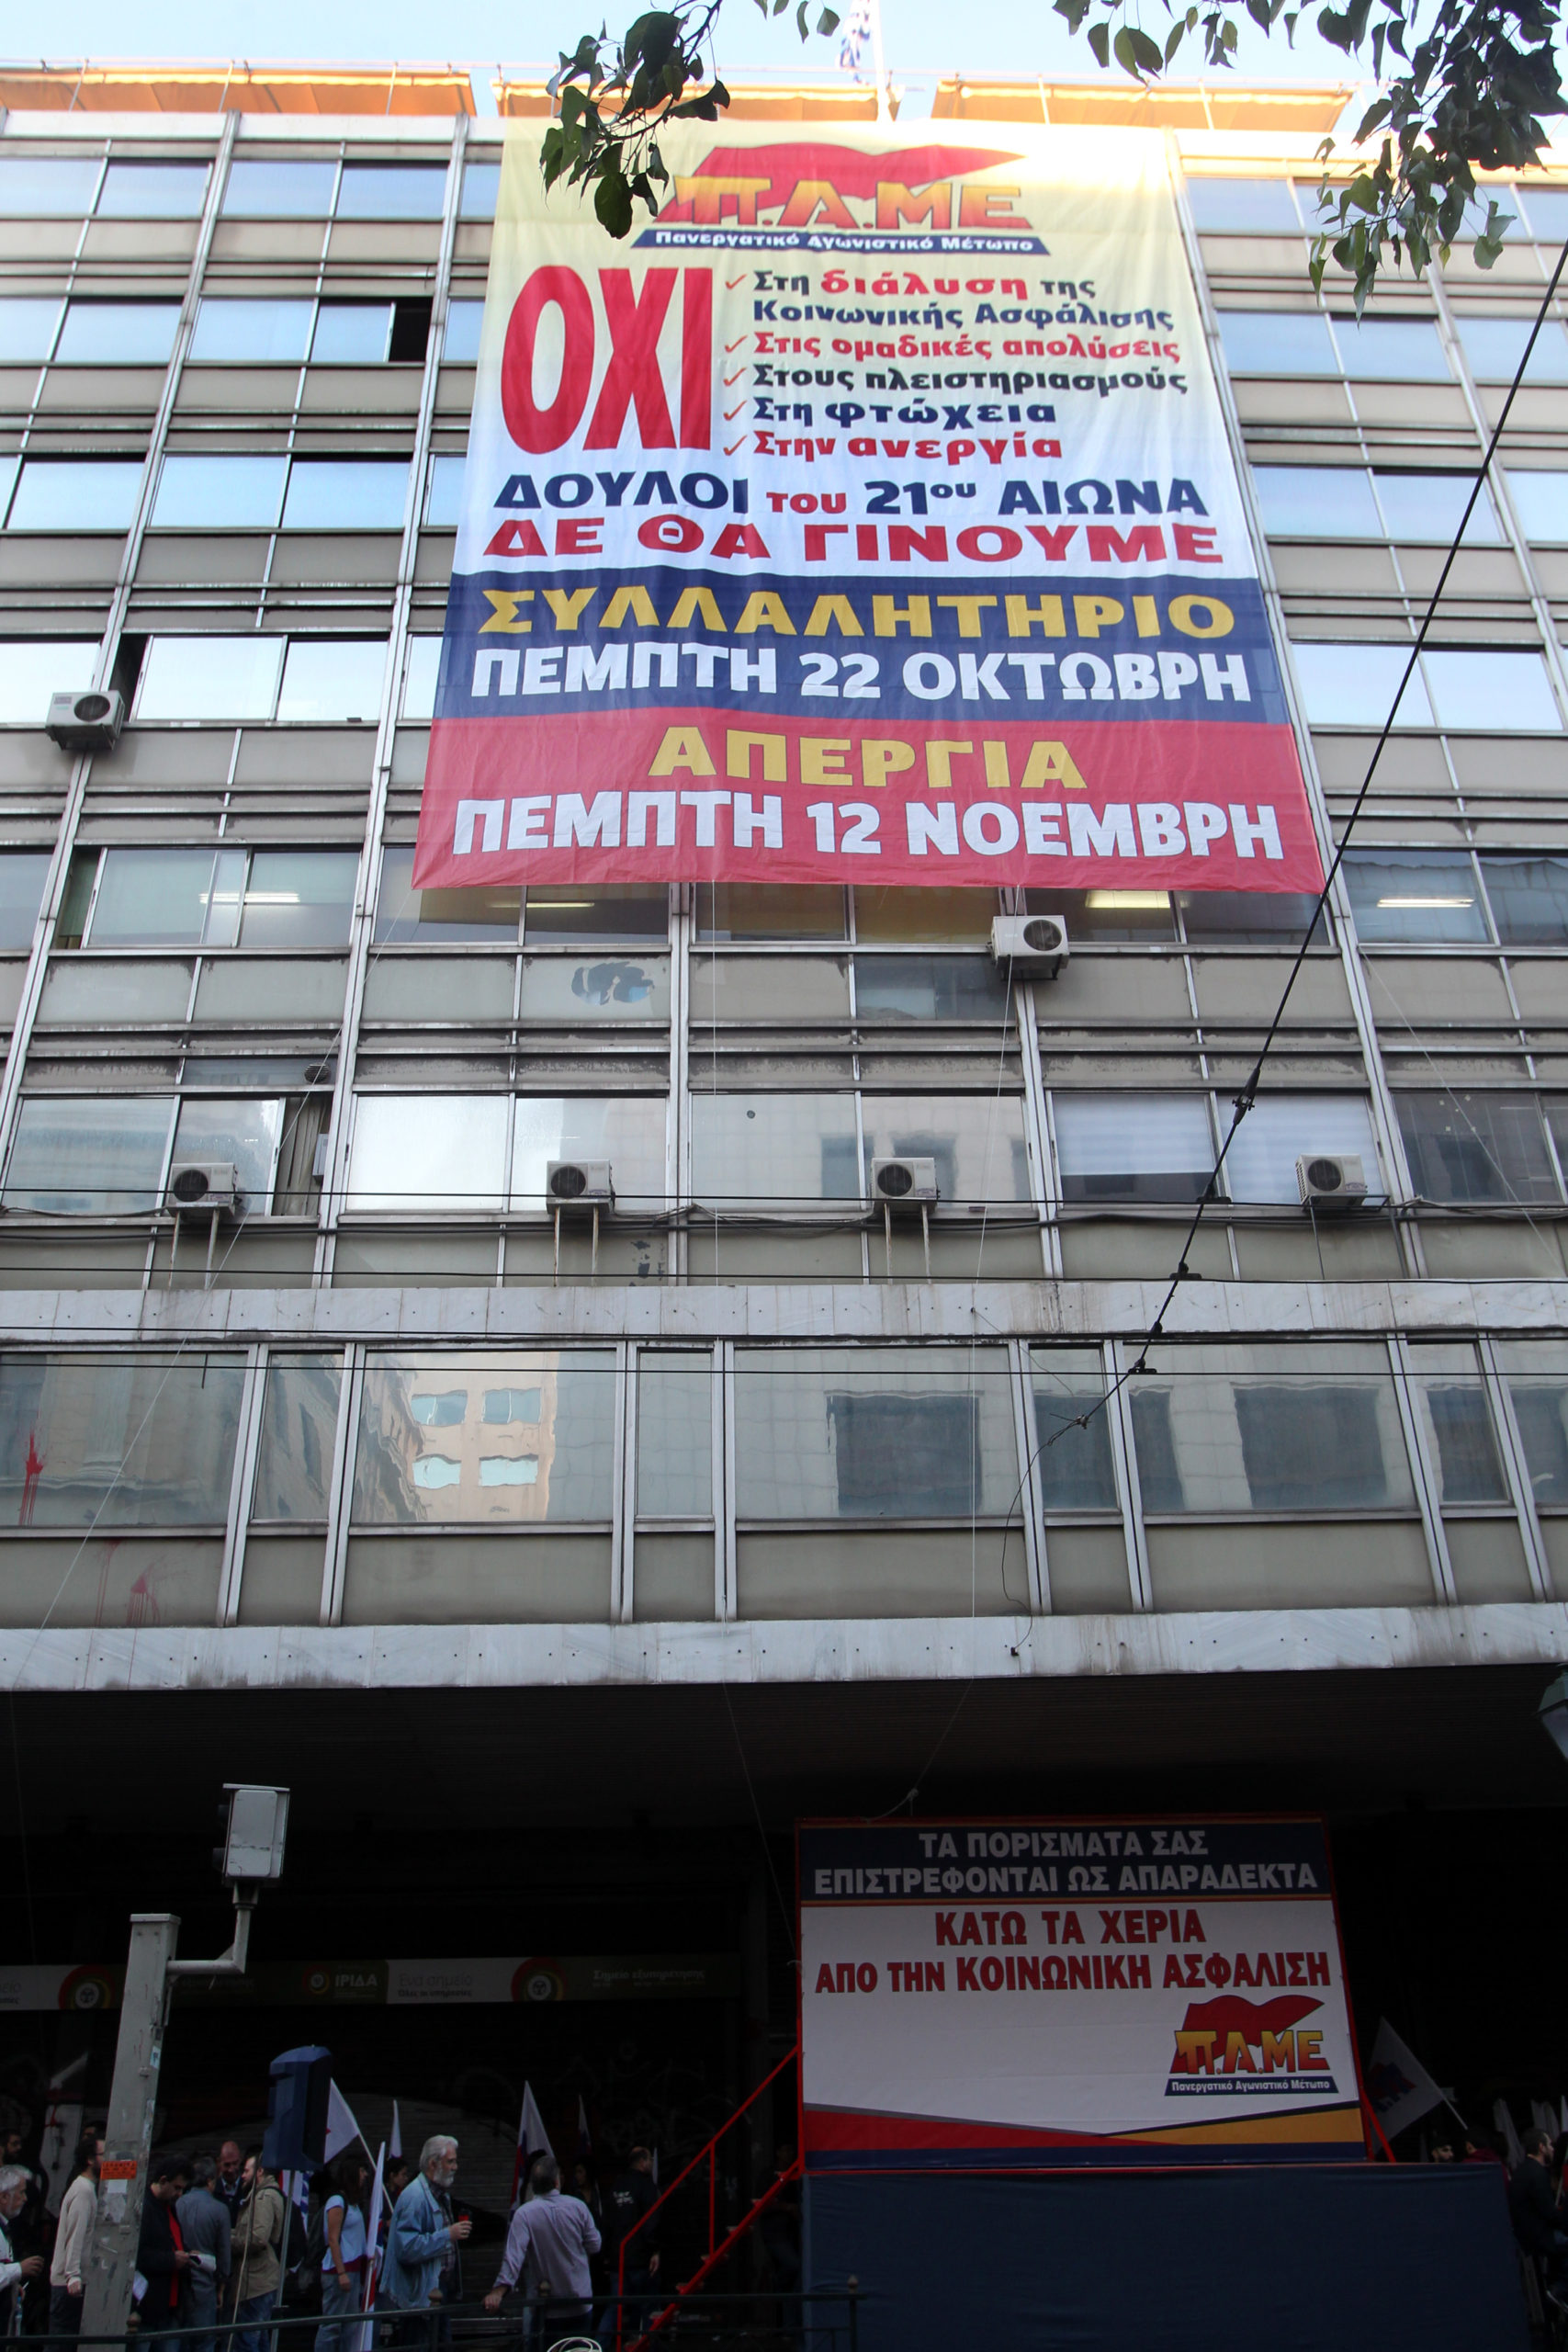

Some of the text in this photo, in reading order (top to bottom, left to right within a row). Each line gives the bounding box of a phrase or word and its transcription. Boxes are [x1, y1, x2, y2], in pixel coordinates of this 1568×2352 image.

[654, 231, 1033, 254] Πανεργατικό Αγωνιστικό Μέτωπο
[753, 269, 1096, 300] Στη διάλυση της
[754, 300, 1174, 333] Κοινωνικής Ασφάλισης
[501, 266, 713, 454] ΟΧΙ
[754, 332, 1180, 363] Στις ομαδικές απολύσεις
[754, 365, 1188, 397] Στους πλειστηριασμούς
[754, 398, 1055, 431] Στη φτώχεια
[754, 431, 1062, 465] Στην ανεργία
[493, 470, 1209, 516] ΔΟΥΛΟΙ του 21ου ΑΙΩΝΑ
[484, 514, 1224, 564] ΔΕ ΘΑ ΓΙΝΟΥΜΕ
[478, 586, 1236, 640] ΣΥΛΛΑΛΗΤΗΡΙΟ
[470, 641, 1253, 703] ΠΕΜΠΤΗ 22 ΟΚΤΩΒΡΗ
[648, 726, 1087, 790] ΑΠΕΡΓΙΑ
[452, 790, 1286, 861] ΠΕΜΠΤΗ 12 ΝΟΕΜΒΡΗ
[919, 1831, 1209, 1859] ΤΑ ΠΟΡΙΣΜΑΤΑ ΣΑΣ
[814, 1863, 1318, 1894] ΕΠΙΣΤΡΕΦΟΝΤΑΙ ΩΣ ΑΠΑΡΑΔΕΚΤΑ
[934, 1909, 1207, 1946] ΚΑΤΩ ΤΑ ΧΕΡΙΑ
[334, 1973, 378, 1987] ΙΡΙΔΑ
[815, 1951, 1331, 1994] ΑΠΟ ΤΗΝ ΚΟΙΝΩΝΙΚΗ ΑΣΦΑΛΙΣΗ
[1171, 2078, 1331, 2094] Πανεργατικό Αγωνιστικό Μέτωπο
